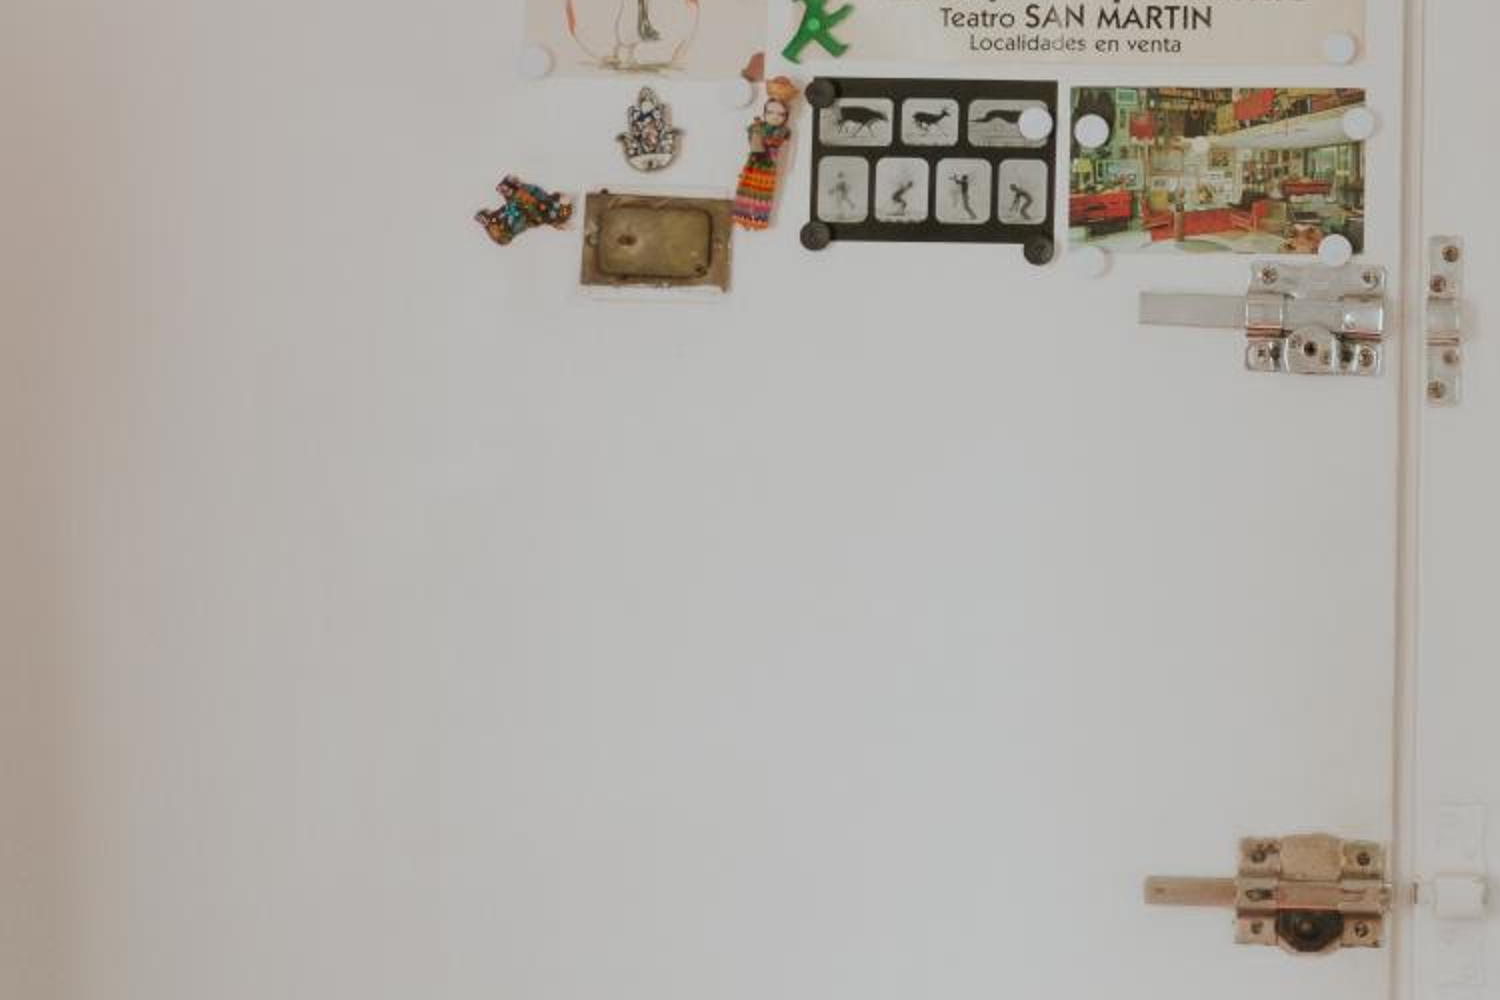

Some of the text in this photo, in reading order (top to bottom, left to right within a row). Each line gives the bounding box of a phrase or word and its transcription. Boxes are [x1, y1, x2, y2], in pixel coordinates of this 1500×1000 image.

[940, 3, 1213, 30] Teatro SAN MARTIN
[970, 34, 1182, 53] Localidades en venta
